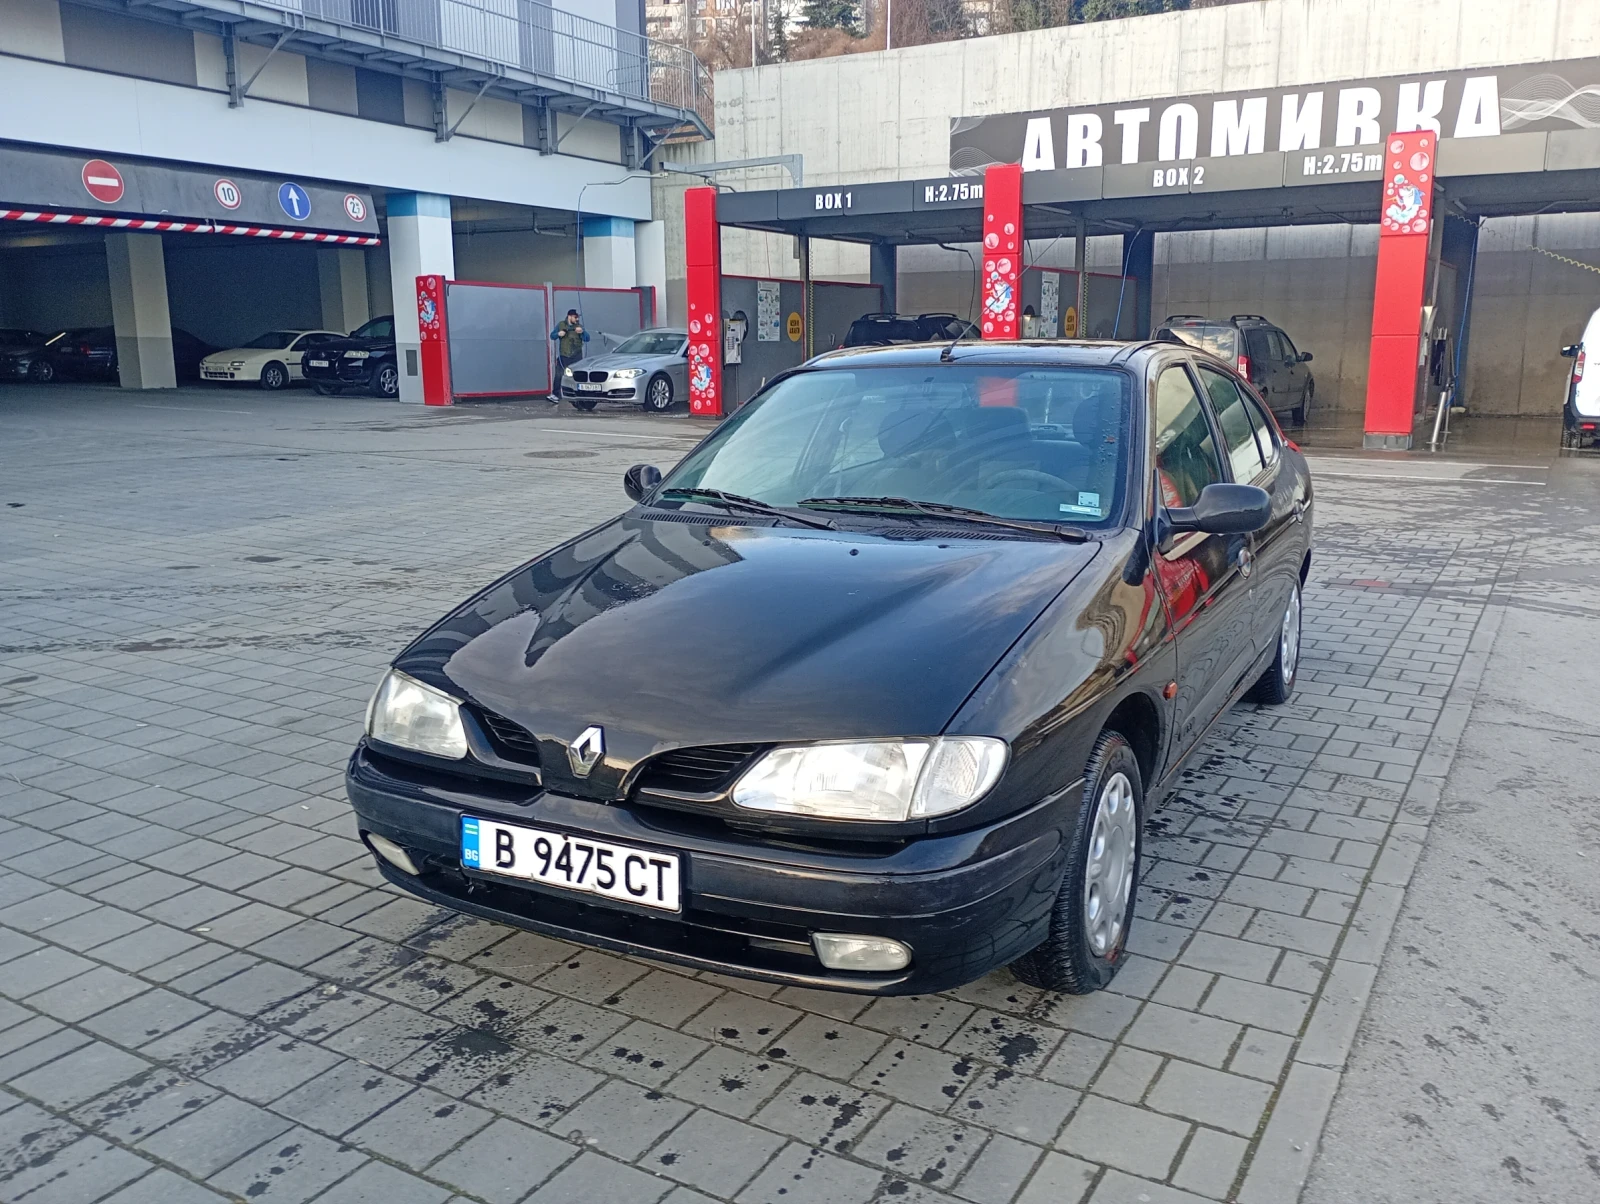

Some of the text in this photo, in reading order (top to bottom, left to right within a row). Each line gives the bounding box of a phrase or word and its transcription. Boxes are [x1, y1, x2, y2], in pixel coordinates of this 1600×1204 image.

[1021, 75, 1501, 173] АВТОМИВКА
[1303, 152, 1382, 176] H:2.75m
[1153, 166, 1204, 188] BOX 2
[221, 187, 235, 202] 10
[815, 192, 852, 210] BOX 1
[925, 182, 983, 203] H:2.75m
[464, 849, 479, 862] BG
[495, 828, 672, 901] B 9475 CT
